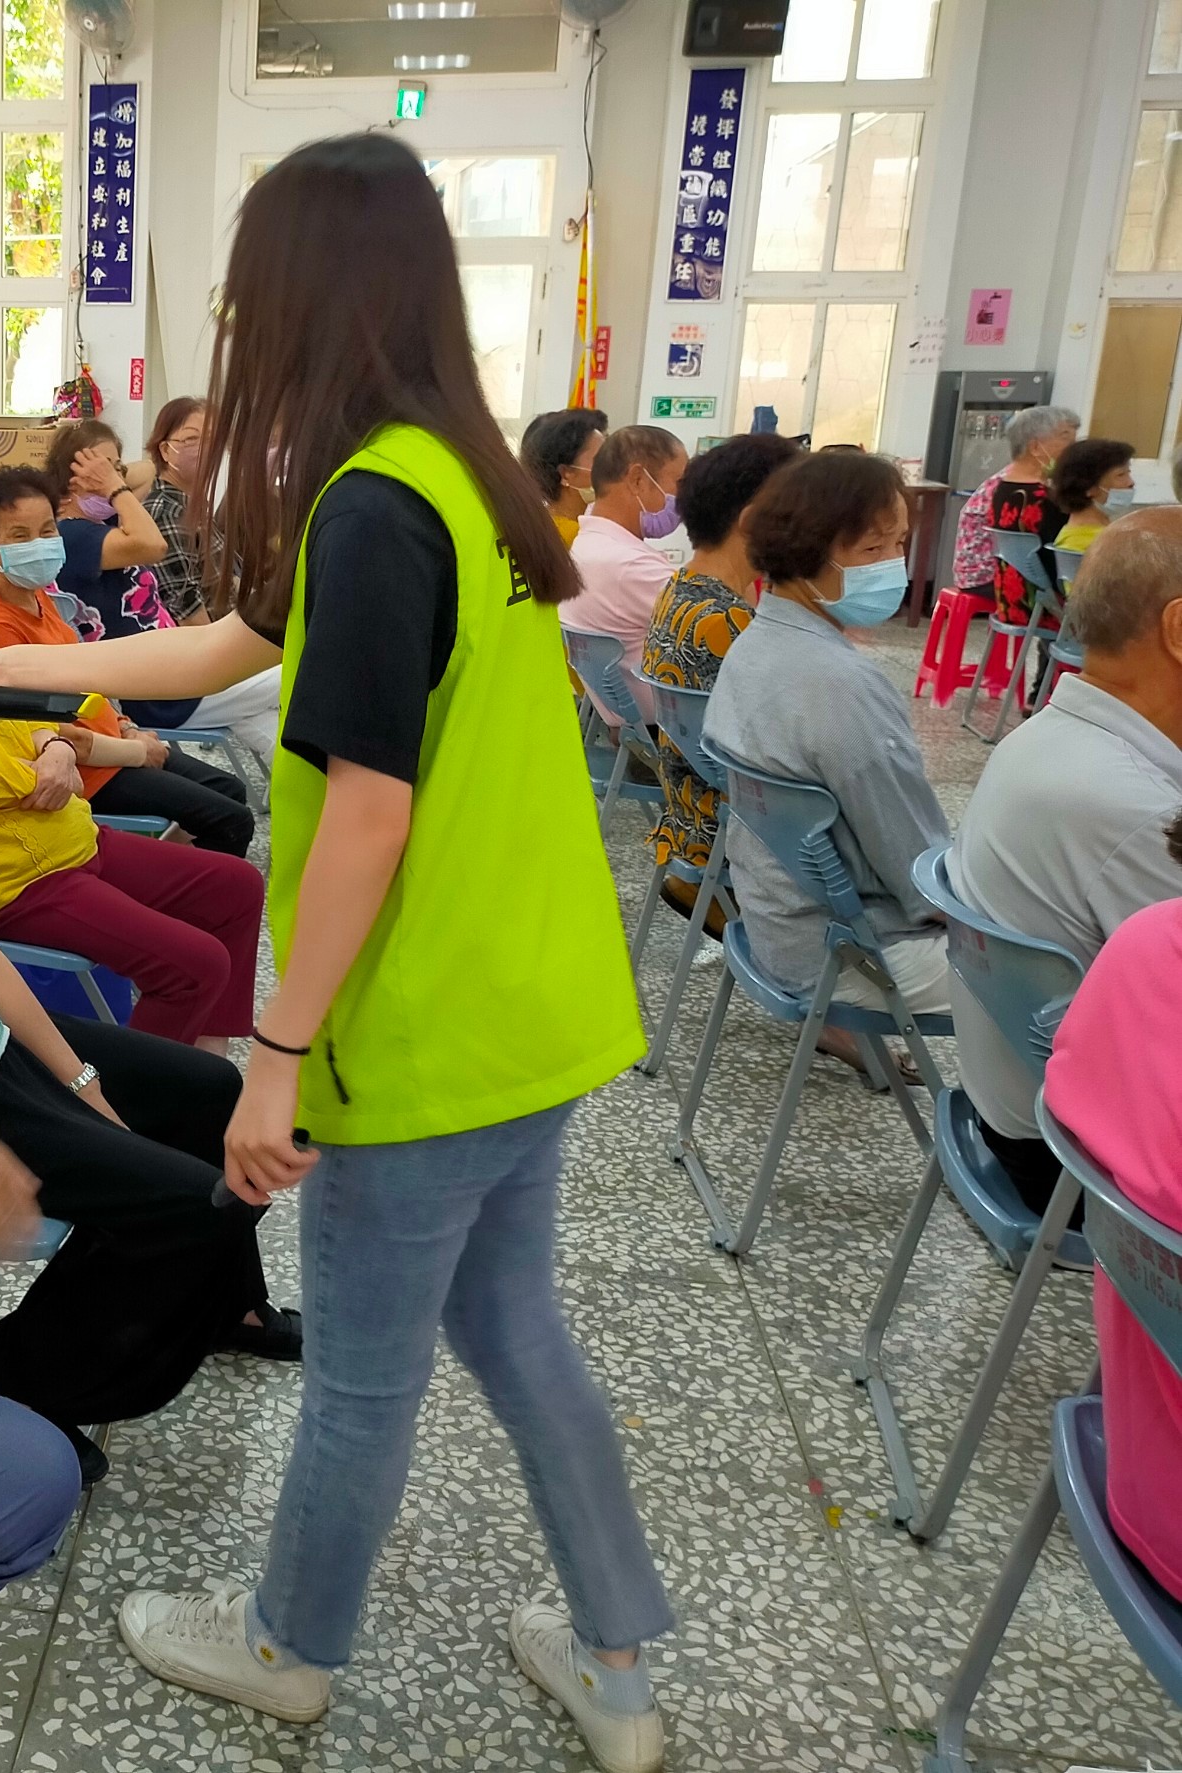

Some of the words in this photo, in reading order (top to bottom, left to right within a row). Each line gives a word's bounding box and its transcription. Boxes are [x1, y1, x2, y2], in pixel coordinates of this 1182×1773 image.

[90, 127, 108, 286] 建立安和社會
[114, 103, 133, 263] 增加福利生產
[704, 88, 738, 258] 發揮組織功能
